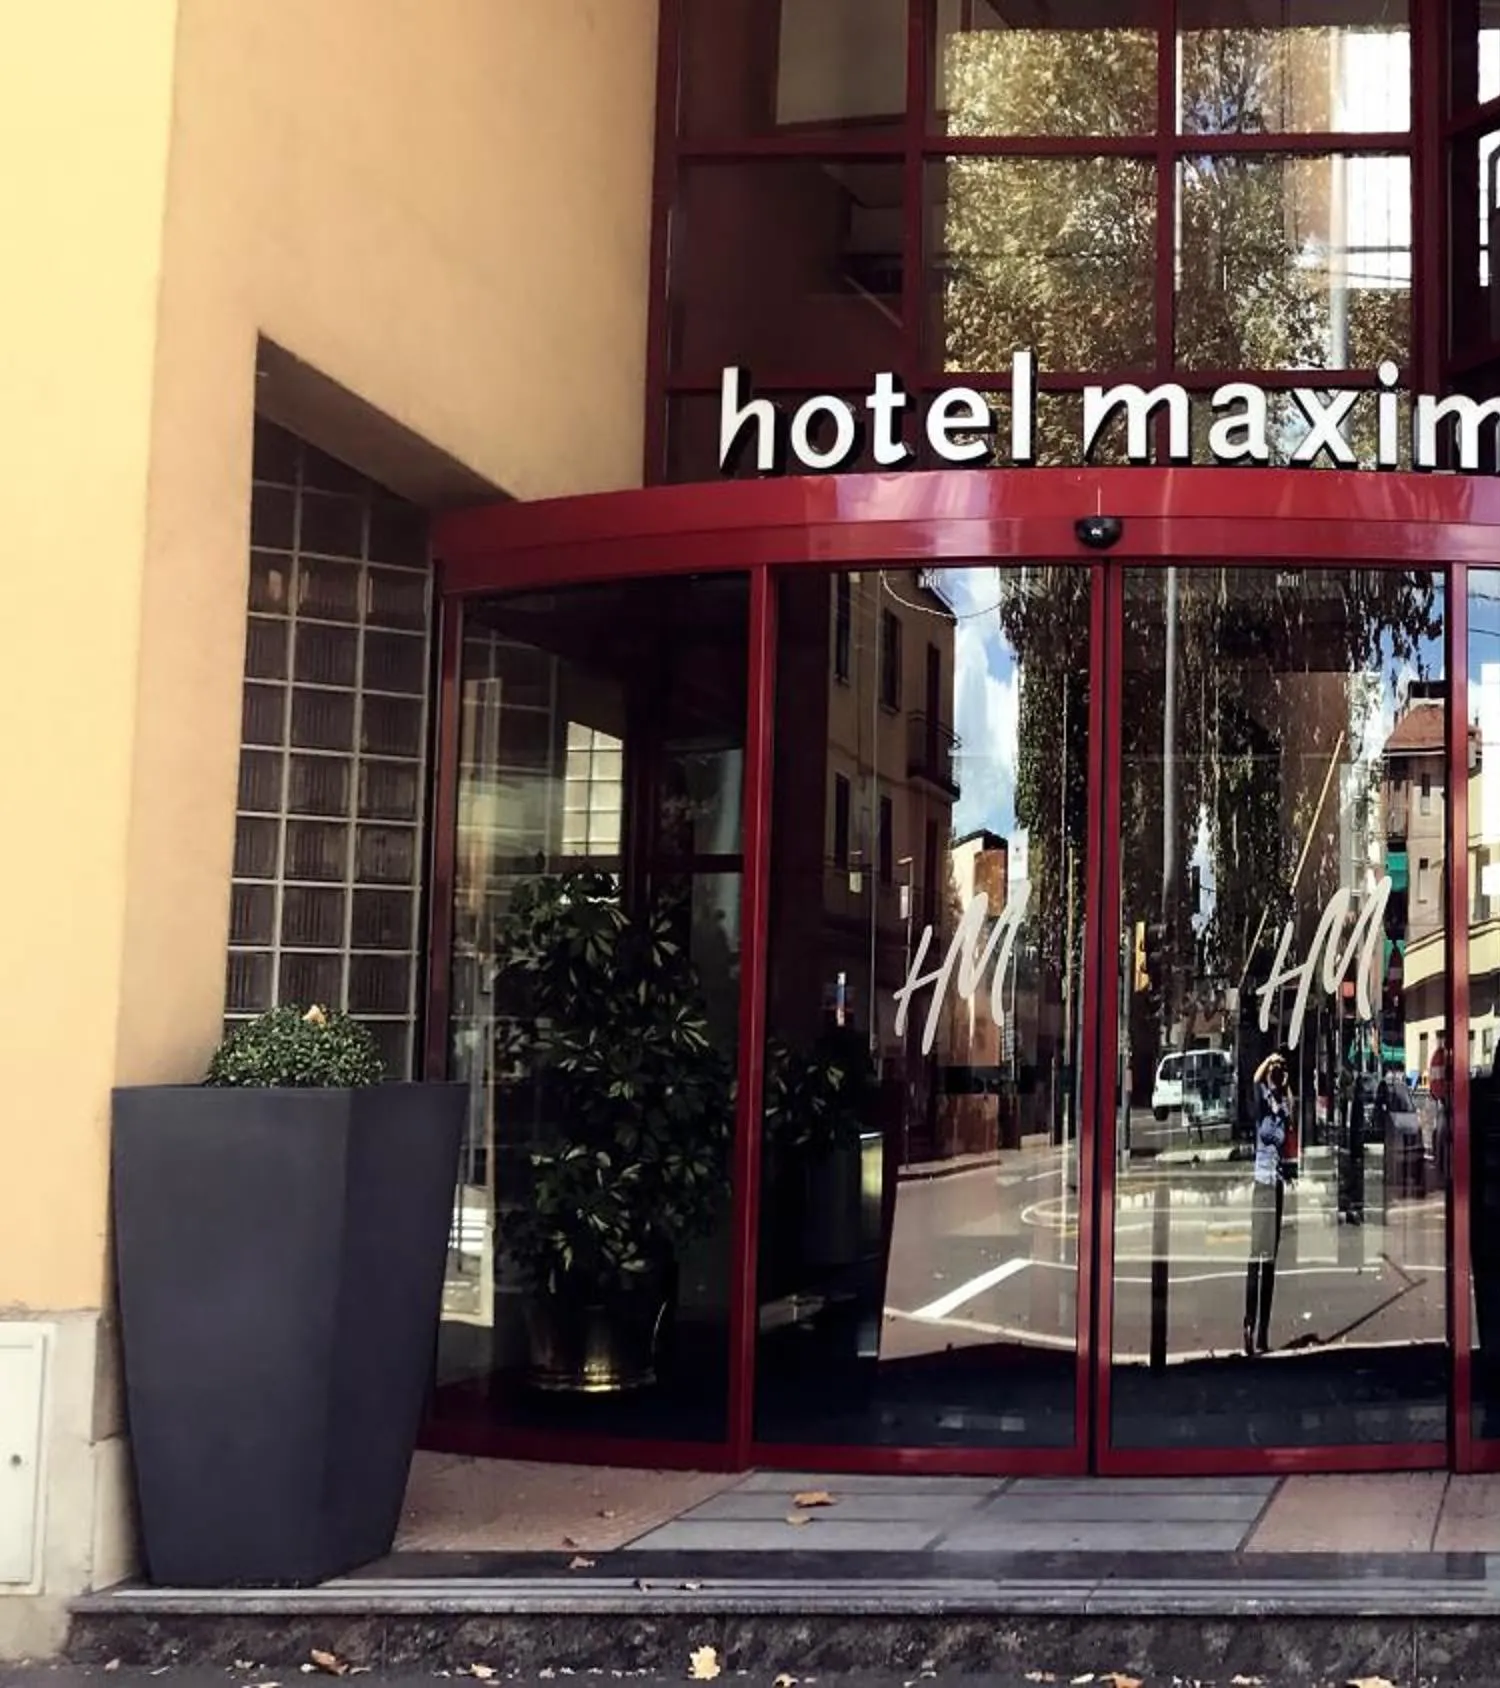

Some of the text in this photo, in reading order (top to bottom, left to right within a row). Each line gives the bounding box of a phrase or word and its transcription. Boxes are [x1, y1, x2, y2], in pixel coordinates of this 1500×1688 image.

[719, 351, 1035, 471] hotel
[893, 879, 1032, 1056] HM
[1255, 875, 1392, 1051] HM
